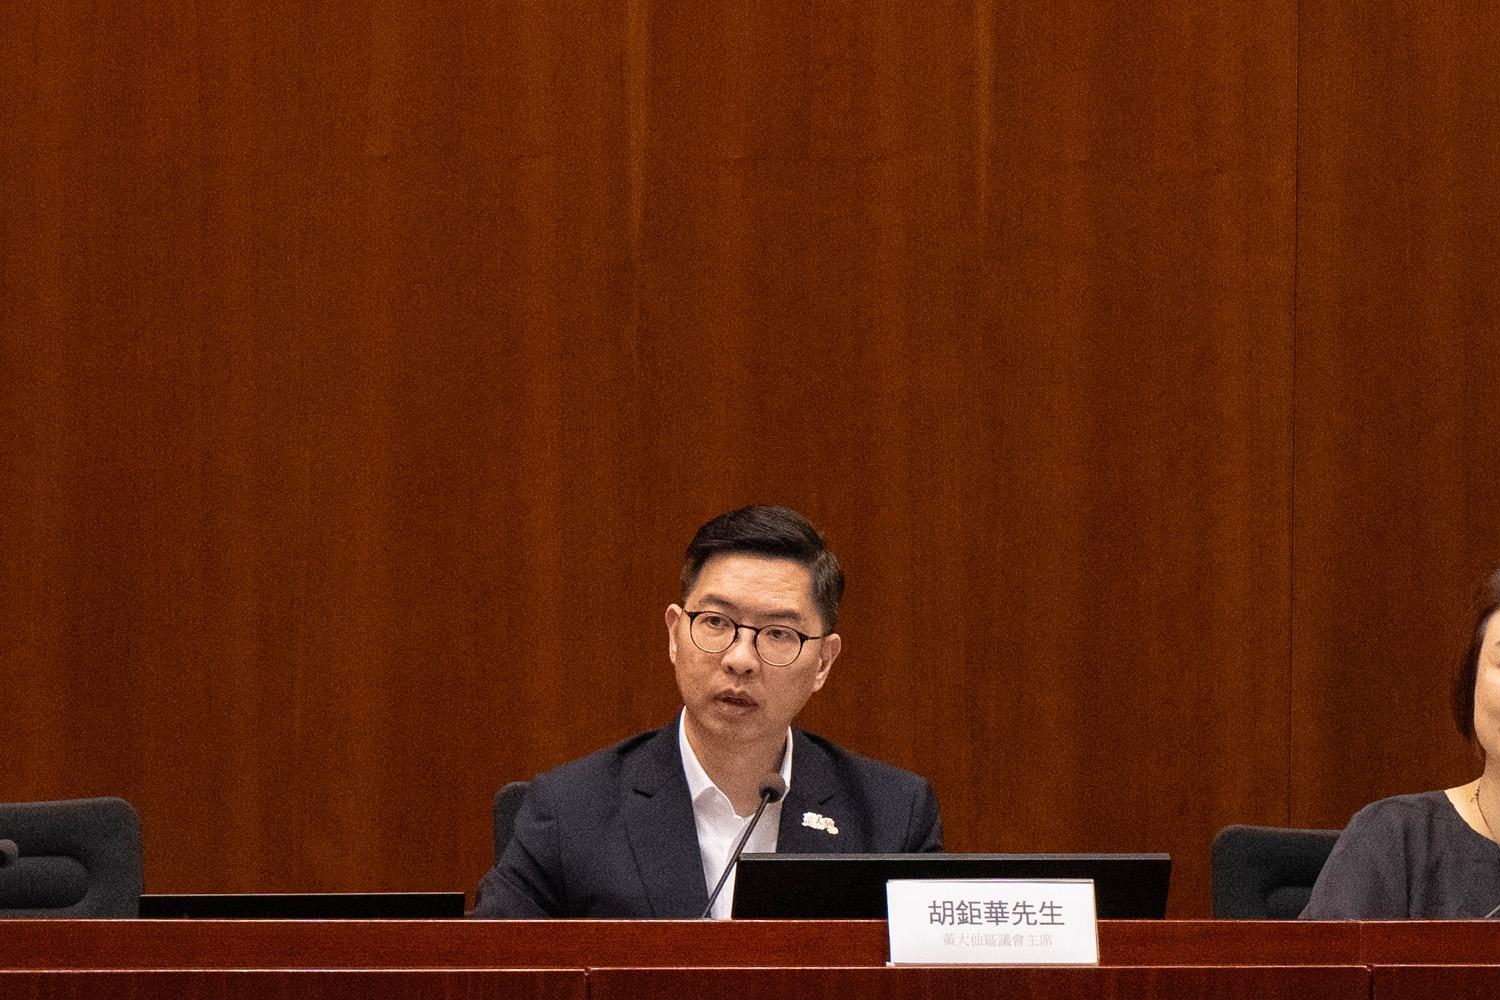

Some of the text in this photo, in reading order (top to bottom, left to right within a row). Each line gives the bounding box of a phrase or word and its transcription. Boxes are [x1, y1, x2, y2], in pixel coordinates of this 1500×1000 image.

[928, 900, 1065, 926] 胡鉅華先生
